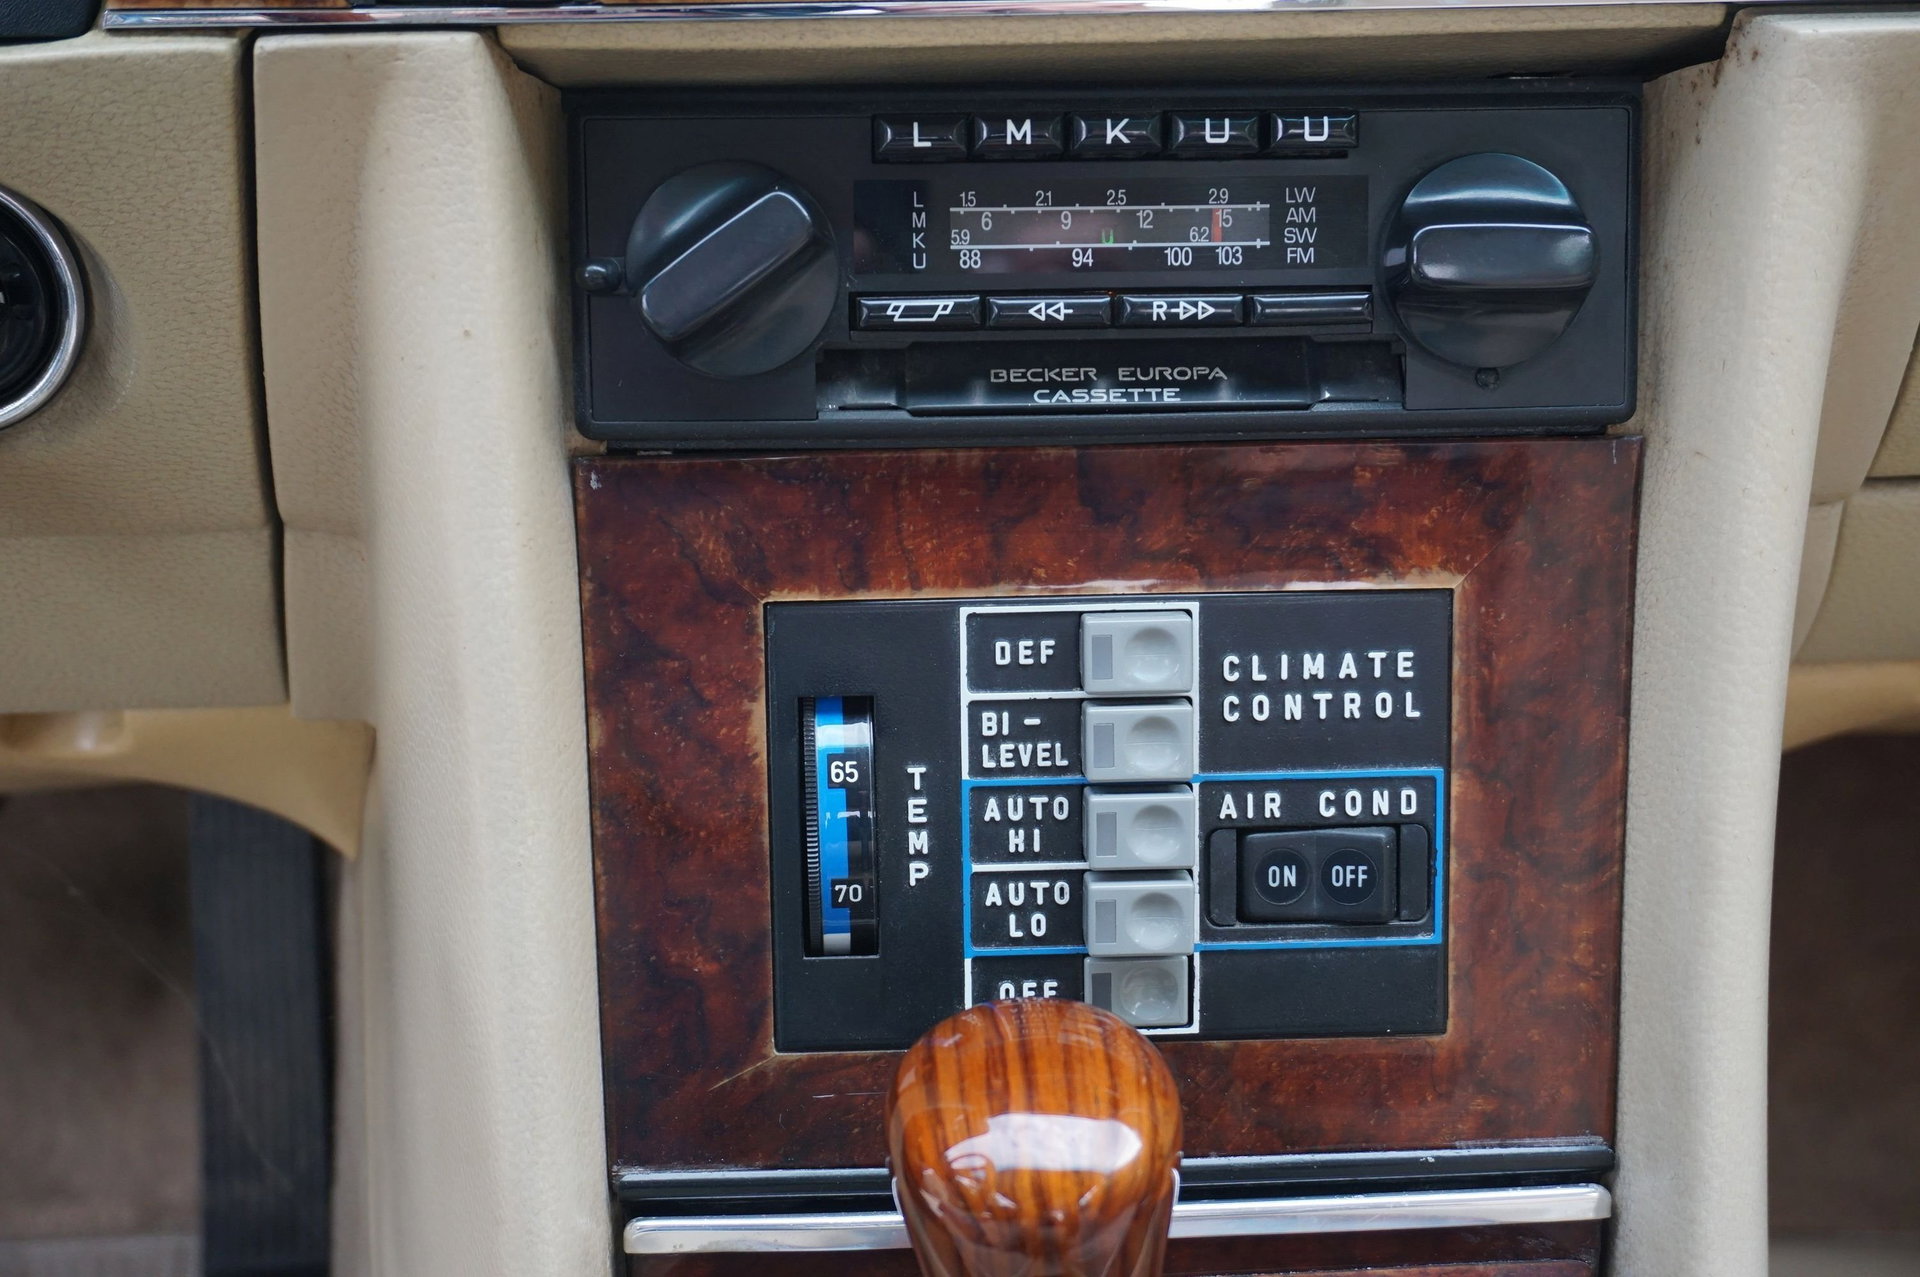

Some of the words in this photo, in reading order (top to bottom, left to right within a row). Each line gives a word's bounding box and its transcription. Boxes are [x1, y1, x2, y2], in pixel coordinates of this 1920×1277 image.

[913, 122, 932, 147] L
[1006, 119, 1032, 145] M
[1106, 118, 1131, 144] K
[1205, 117, 1230, 144] U
[1304, 116, 1329, 142] U
[913, 191, 924, 207] L
[1106, 189, 1127, 205] 2.5
[1208, 188, 1229, 204] 2.9
[1285, 187, 1316, 203] LW
[912, 211, 926, 228] M
[981, 211, 993, 231] 6
[1060, 210, 1072, 229] 9
[1136, 209, 1154, 229] 12
[1215, 208, 1233, 227] 15
[1286, 207, 1316, 223] AM
[912, 232, 926, 249] K
[1189, 226, 1210, 243] 6.2
[1284, 227, 1318, 244] SW
[912, 252, 927, 270] U
[959, 249, 982, 269] 88
[1071, 248, 1094, 267] 94
[1164, 246, 1193, 266] 100
[1215, 246, 1243, 265] 103
[1287, 247, 1315, 264] FM
[990, 368, 1097, 383] BECKER
[1118, 366, 1229, 382] EUROPA
[1032, 388, 1181, 404] CASSETTE
[995, 640, 1056, 665] DEF
[1222, 651, 1415, 682] CLIMATE
[1222, 691, 1421, 722] CONTROL
[982, 742, 1069, 768] LEVEL
[830, 760, 859, 783] 65
[983, 796, 1069, 822] AUTO
[1219, 792, 1281, 820] AIR
[1318, 789, 1417, 818] COND
[1008, 828, 1041, 853] HI
[1267, 865, 1297, 888] ON
[1331, 865, 1368, 888] OFF
[833, 884, 863, 903] 70
[984, 881, 1070, 907] AUTO
[1008, 913, 1047, 938] LO
